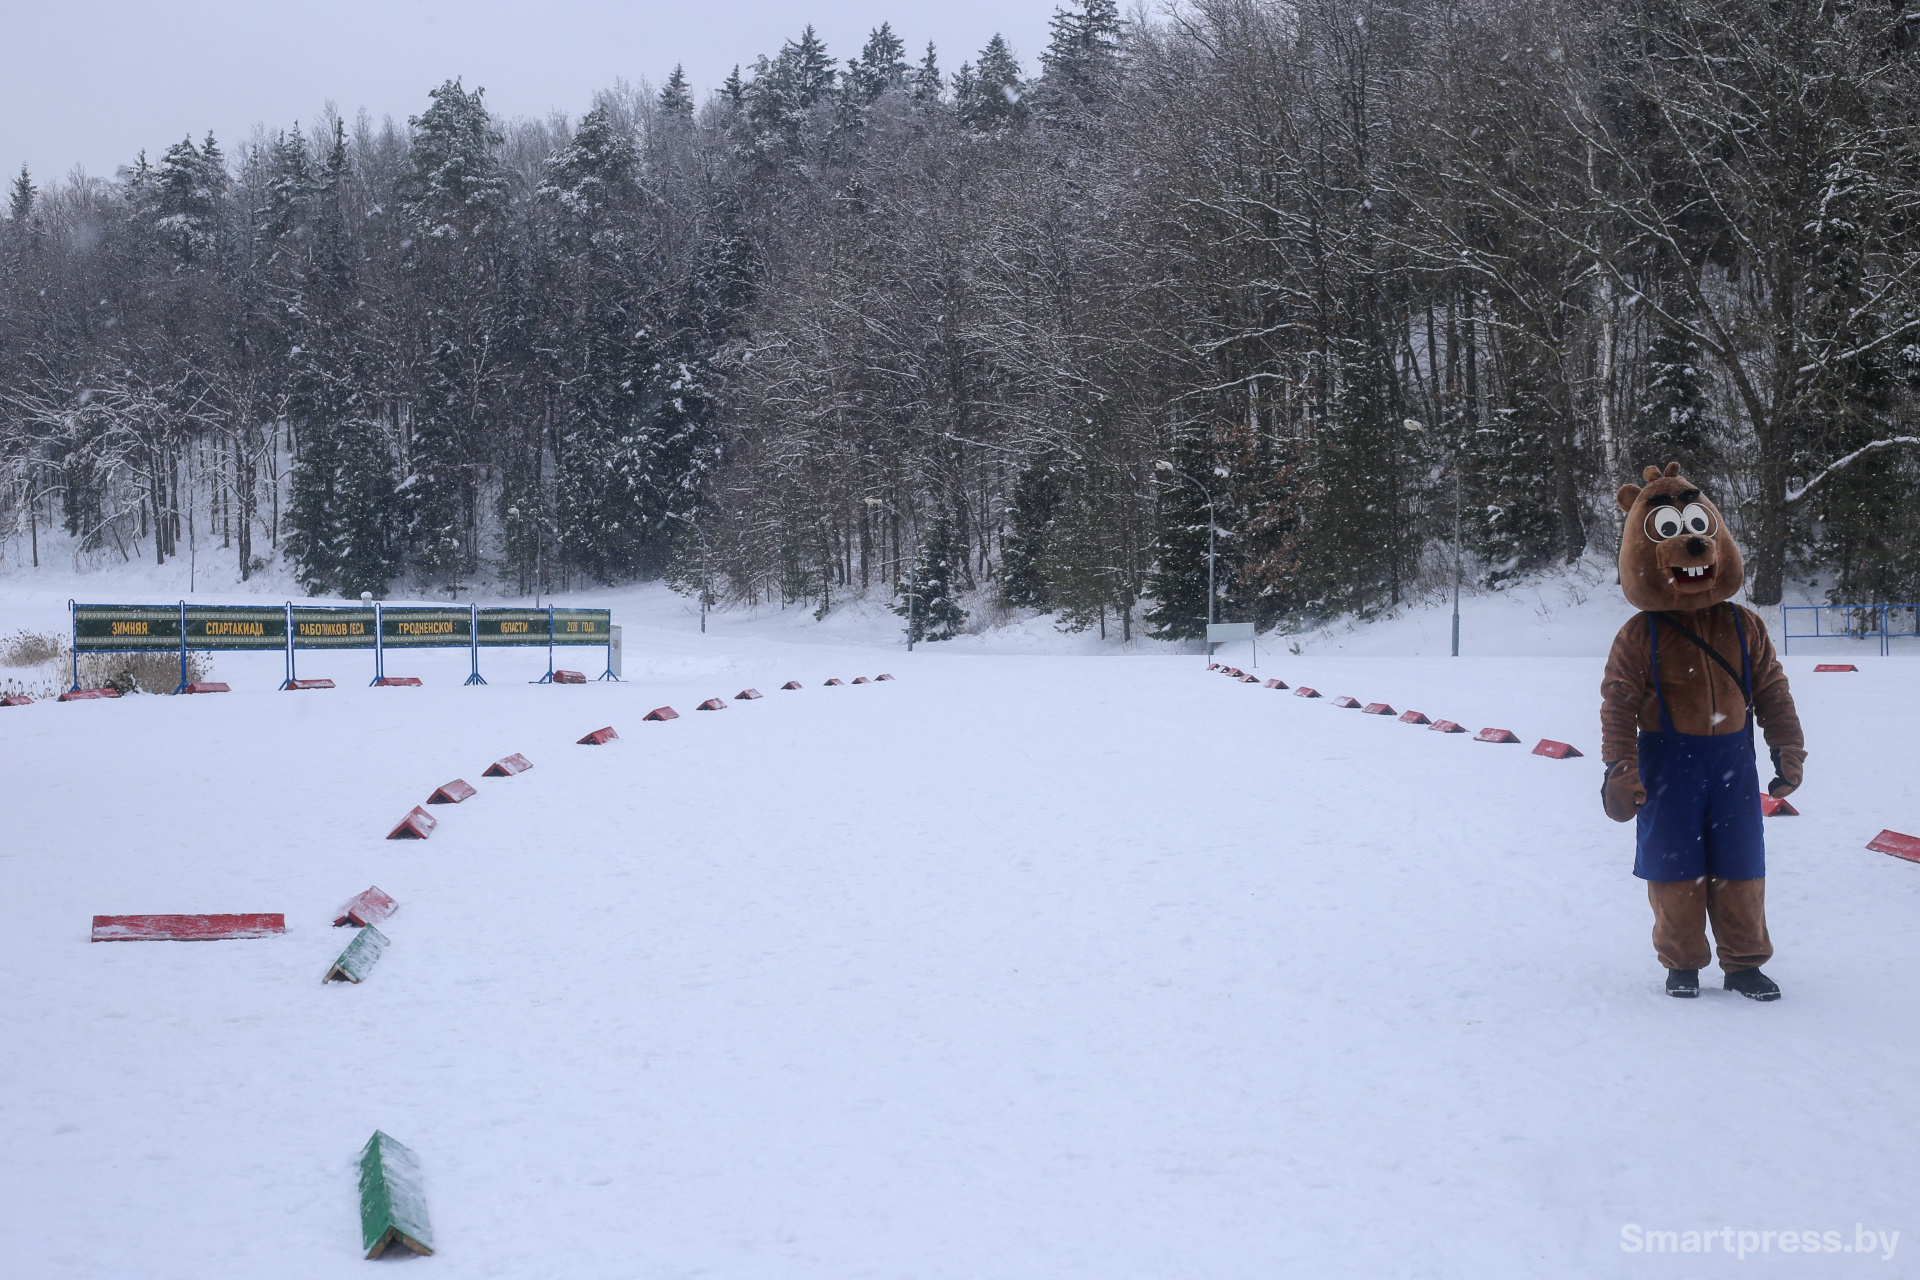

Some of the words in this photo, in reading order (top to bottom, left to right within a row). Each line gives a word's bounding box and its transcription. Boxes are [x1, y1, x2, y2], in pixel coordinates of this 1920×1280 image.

[111, 621, 148, 635] ЗИМНЯЯ
[205, 621, 264, 637] СПАРТАКИАДА
[398, 618, 453, 635] ГРОДНЕНСКОЙ
[500, 622, 528, 633] ОБЛАСТИ
